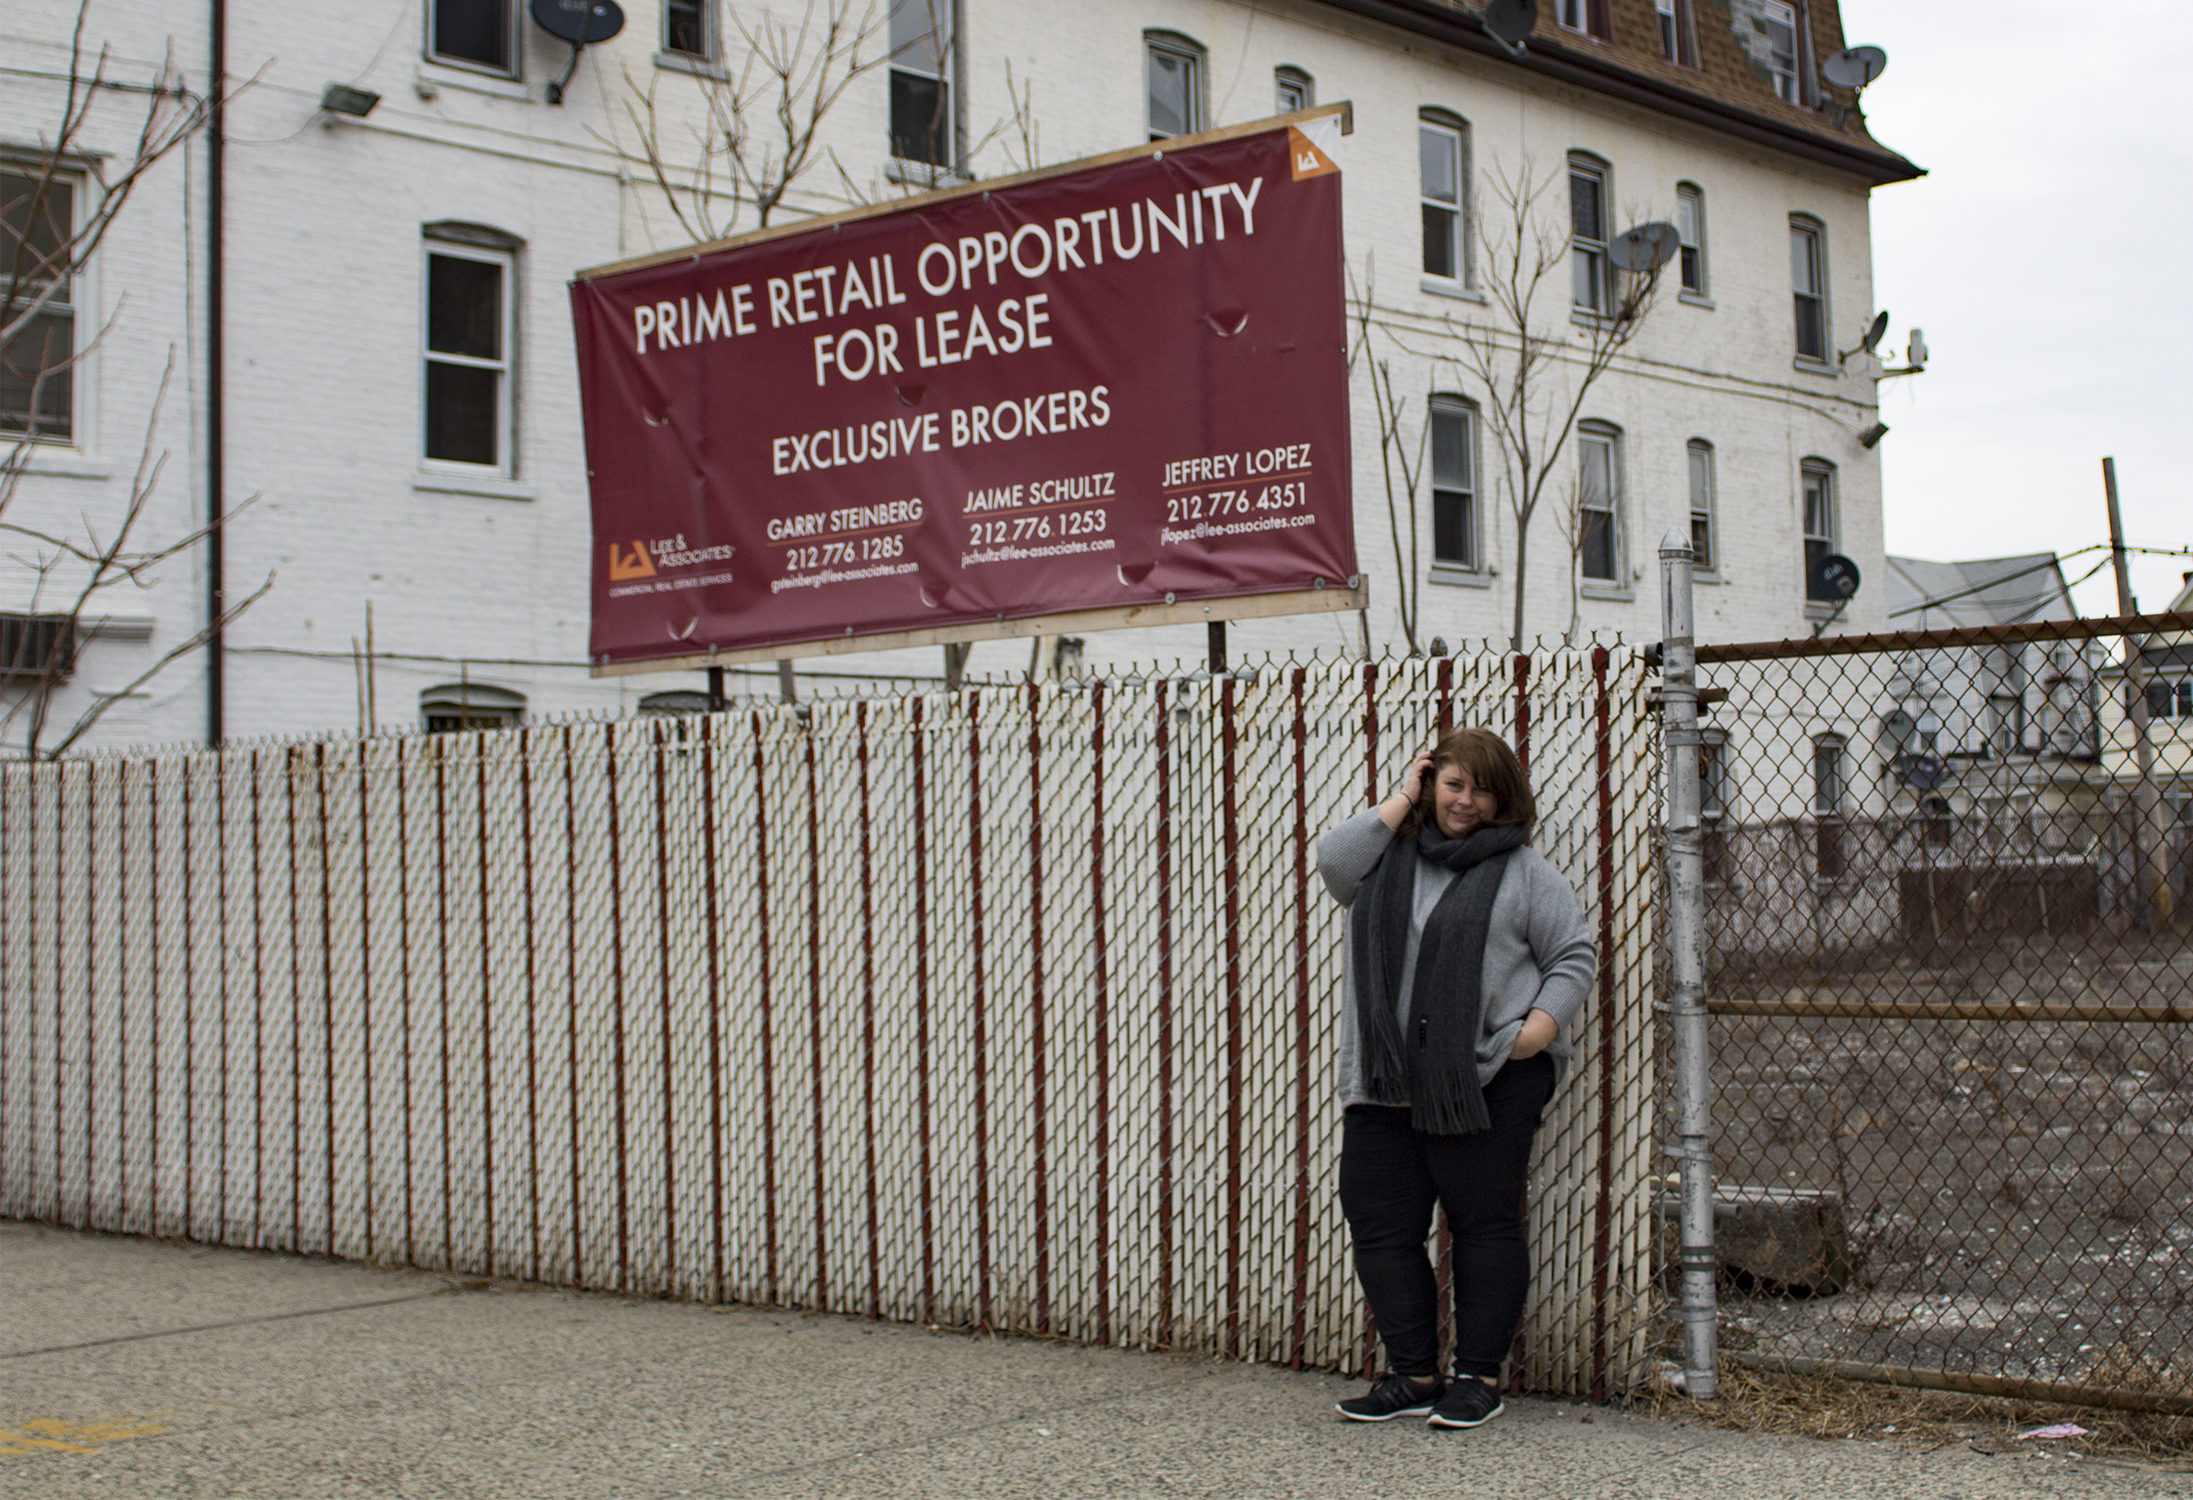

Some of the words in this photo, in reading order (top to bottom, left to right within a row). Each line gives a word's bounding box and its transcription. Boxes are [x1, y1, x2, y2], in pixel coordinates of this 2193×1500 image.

[634, 283, 757, 355] PRIME
[767, 252, 907, 328] RETAIL
[917, 176, 1263, 297] OPPORTUNITY
[813, 323, 904, 387] FOR
[915, 293, 1053, 368] LEASE
[773, 412, 940, 476] EXCLUSIVE
[951, 385, 1112, 448] BROKERS
[1162, 453, 1240, 487] JEFFREY
[1246, 443, 1312, 475] LOPEZ
[962, 484, 1024, 513] JAIME
[1029, 471, 1115, 505] SCHULTZ
[767, 512, 827, 541] GARRY
[830, 498, 923, 532] STEINBERG
[1161, 513, 1315, 547] jlopez@lee-associates.com
[650, 538, 676, 555] LEE
[675, 533, 687, 551] &
[961, 538, 1115, 570] jschultz@lee-associates.com
[655, 581, 673, 592] REAL
[771, 562, 919, 594] gsteinberg@lee-associates.com
